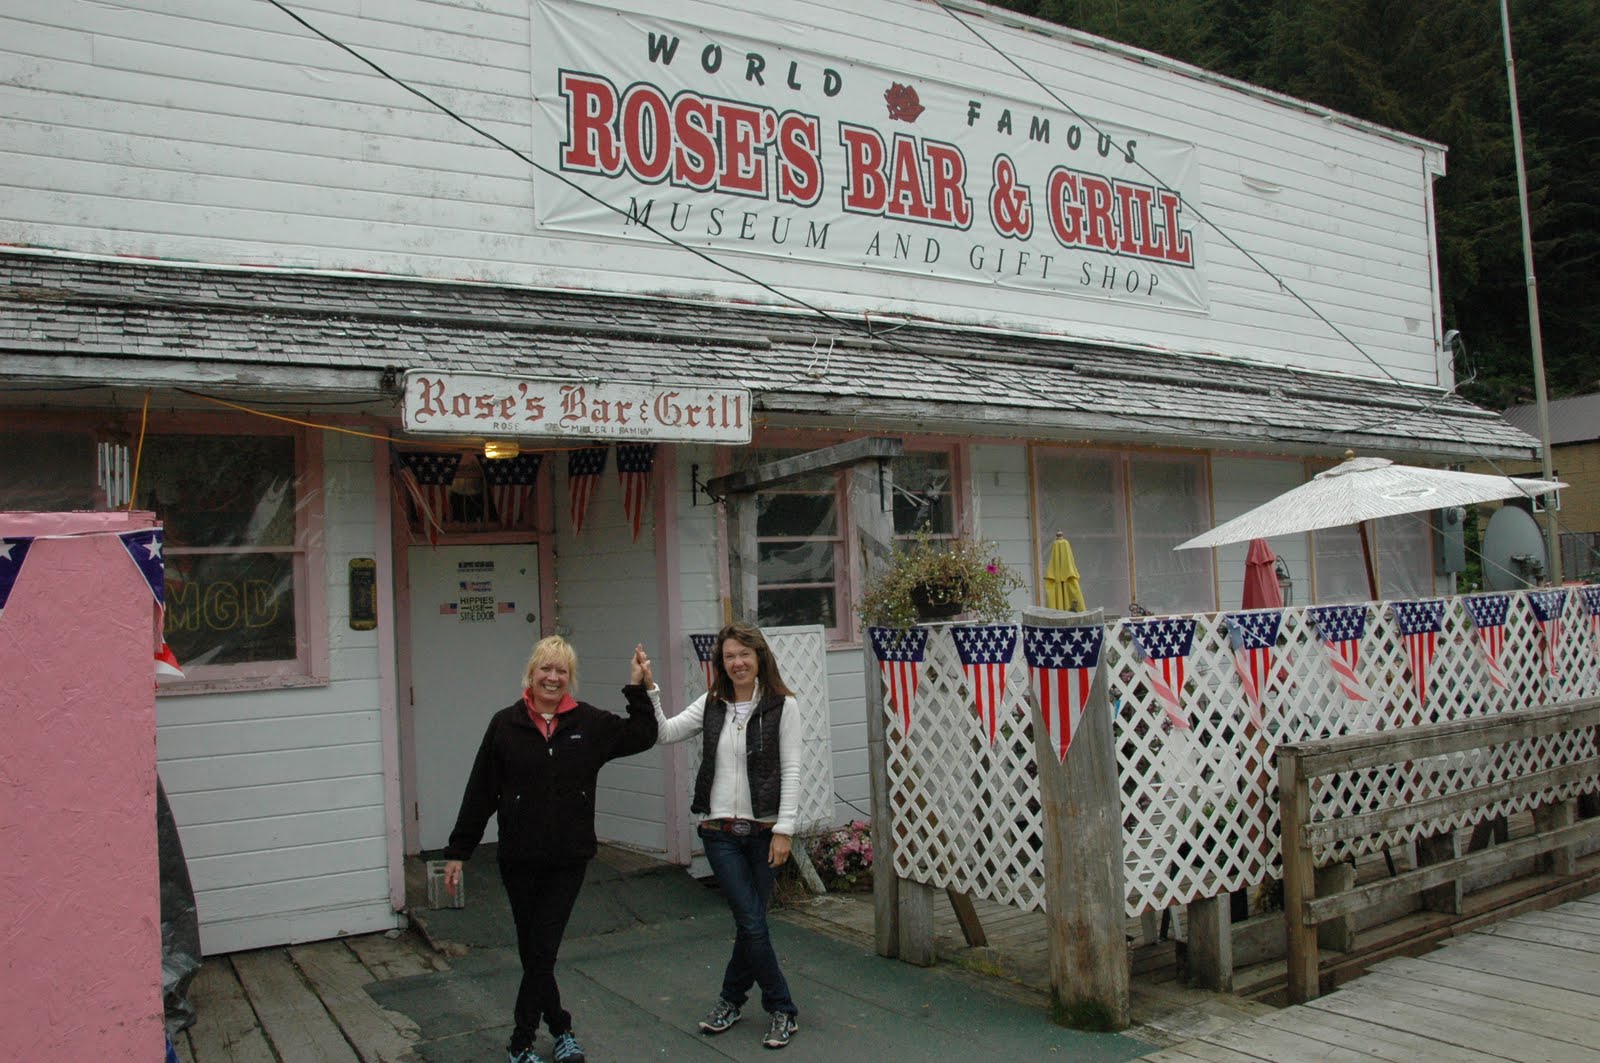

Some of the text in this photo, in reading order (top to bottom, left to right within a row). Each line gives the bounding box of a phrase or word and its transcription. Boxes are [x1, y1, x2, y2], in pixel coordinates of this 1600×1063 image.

[647, 32, 1138, 164] WORLD FAMOUS
[558, 68, 1195, 269] ROSE'S BAR & GRILL
[624, 196, 1160, 297] MUSEUM AND GIFT SHOP
[414, 377, 546, 424] Rose's
[559, 385, 633, 429] Bar
[653, 391, 744, 430] Grill
[492, 421, 520, 431] ROSE
[164, 579, 279, 633] MGD
[460, 611, 495, 621] SIDE DOOR
